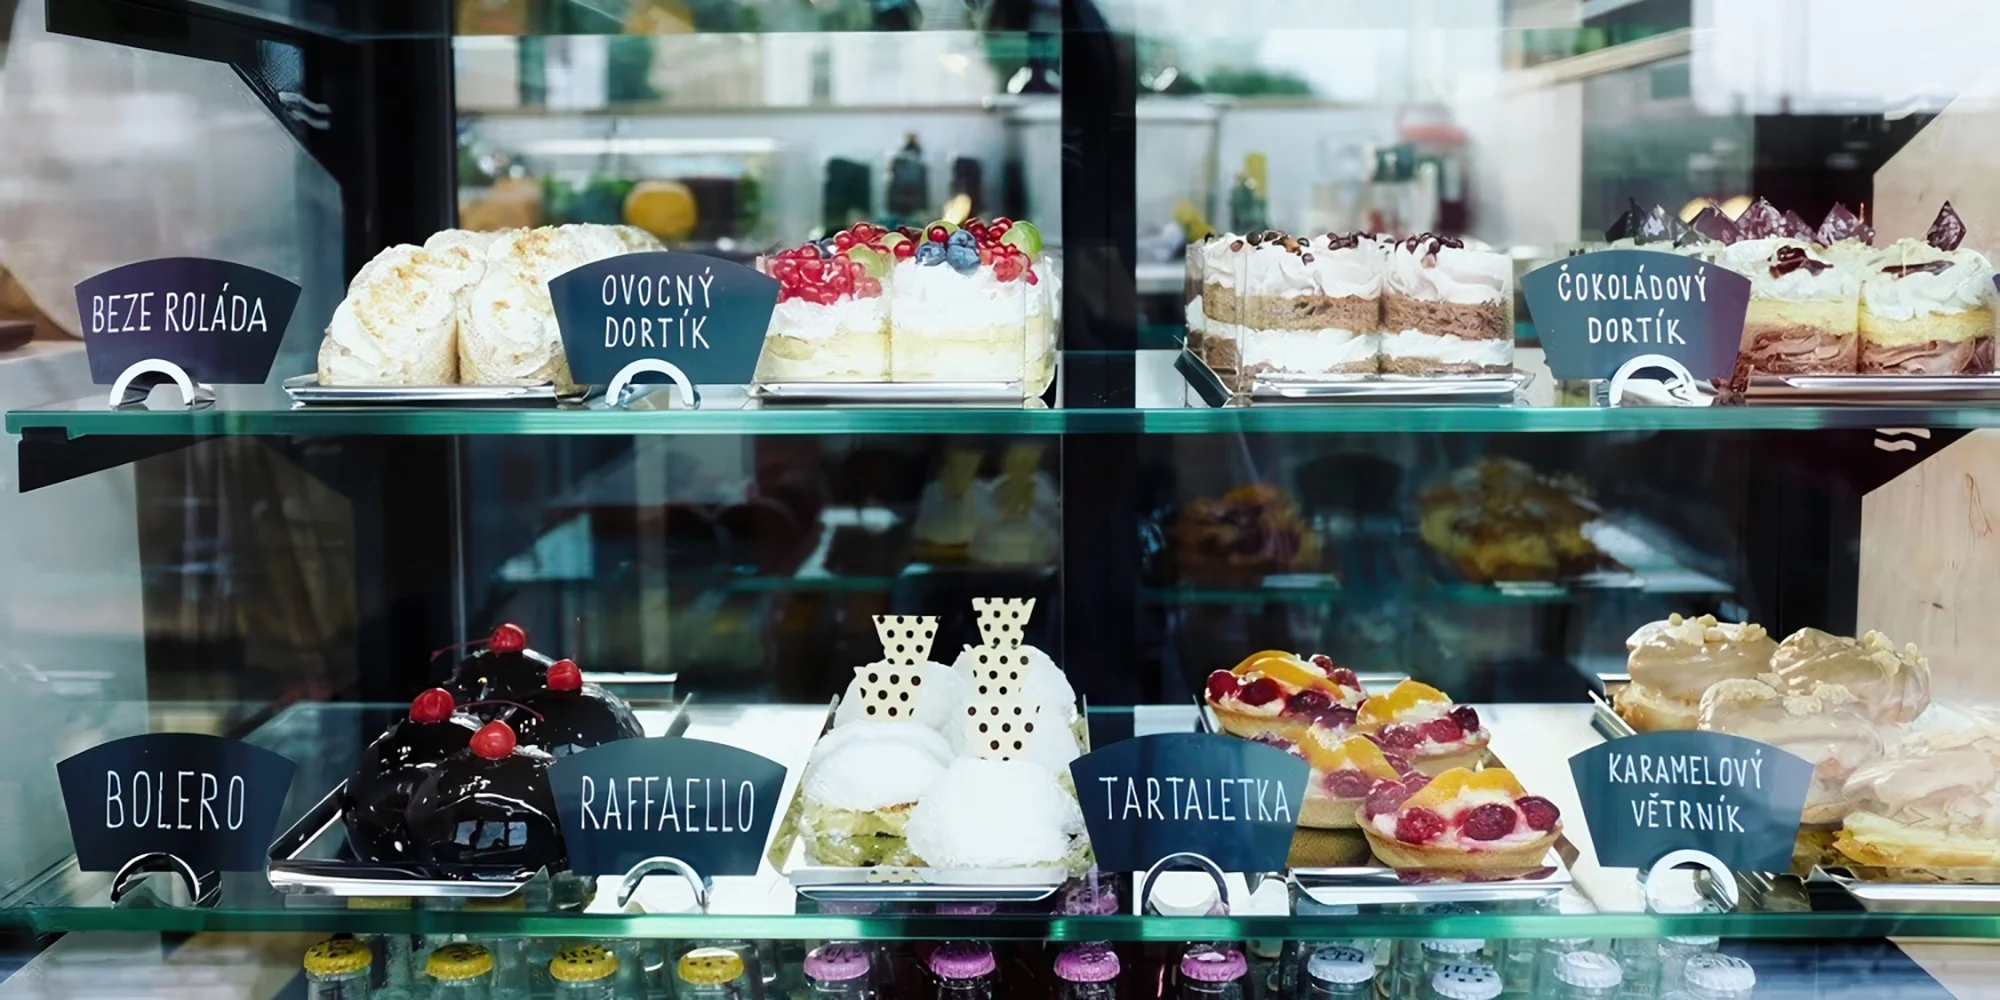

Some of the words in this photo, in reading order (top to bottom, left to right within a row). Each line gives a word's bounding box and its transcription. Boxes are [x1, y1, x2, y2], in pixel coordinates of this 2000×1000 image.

[602, 266, 714, 309] OVOCNÝ
[1557, 264, 1708, 303] ČOKOLÁDOVÝ
[92, 291, 154, 333] BEZE
[164, 284, 268, 333] ROLÁDA
[604, 309, 711, 349] DORTÍK
[1587, 310, 1687, 346] DORTÍK
[1607, 748, 1763, 787] KARAMELOVÝ
[106, 770, 244, 830] BOLERO
[581, 775, 755, 834] RAFFAELLO
[1099, 775, 1293, 823] TARTALETKA
[1630, 792, 1745, 834] VĚTRNÍK
